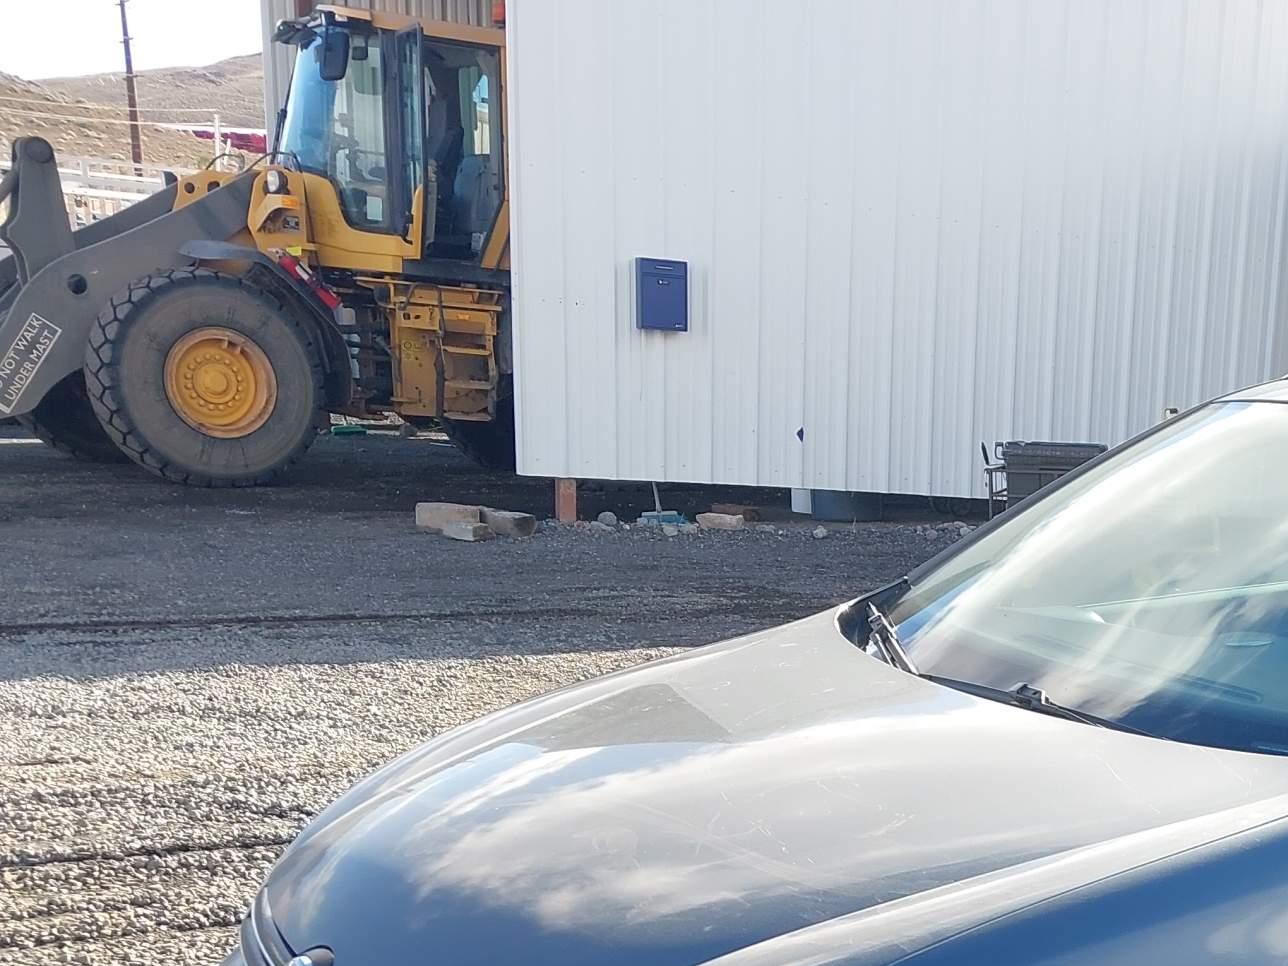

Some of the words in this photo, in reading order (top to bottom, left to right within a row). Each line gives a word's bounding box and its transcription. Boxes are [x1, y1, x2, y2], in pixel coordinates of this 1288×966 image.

[1, 350, 21, 379] NOT
[14, 316, 43, 351] WALK
[4, 360, 35, 400] UNDER
[28, 328, 54, 362] MAST
